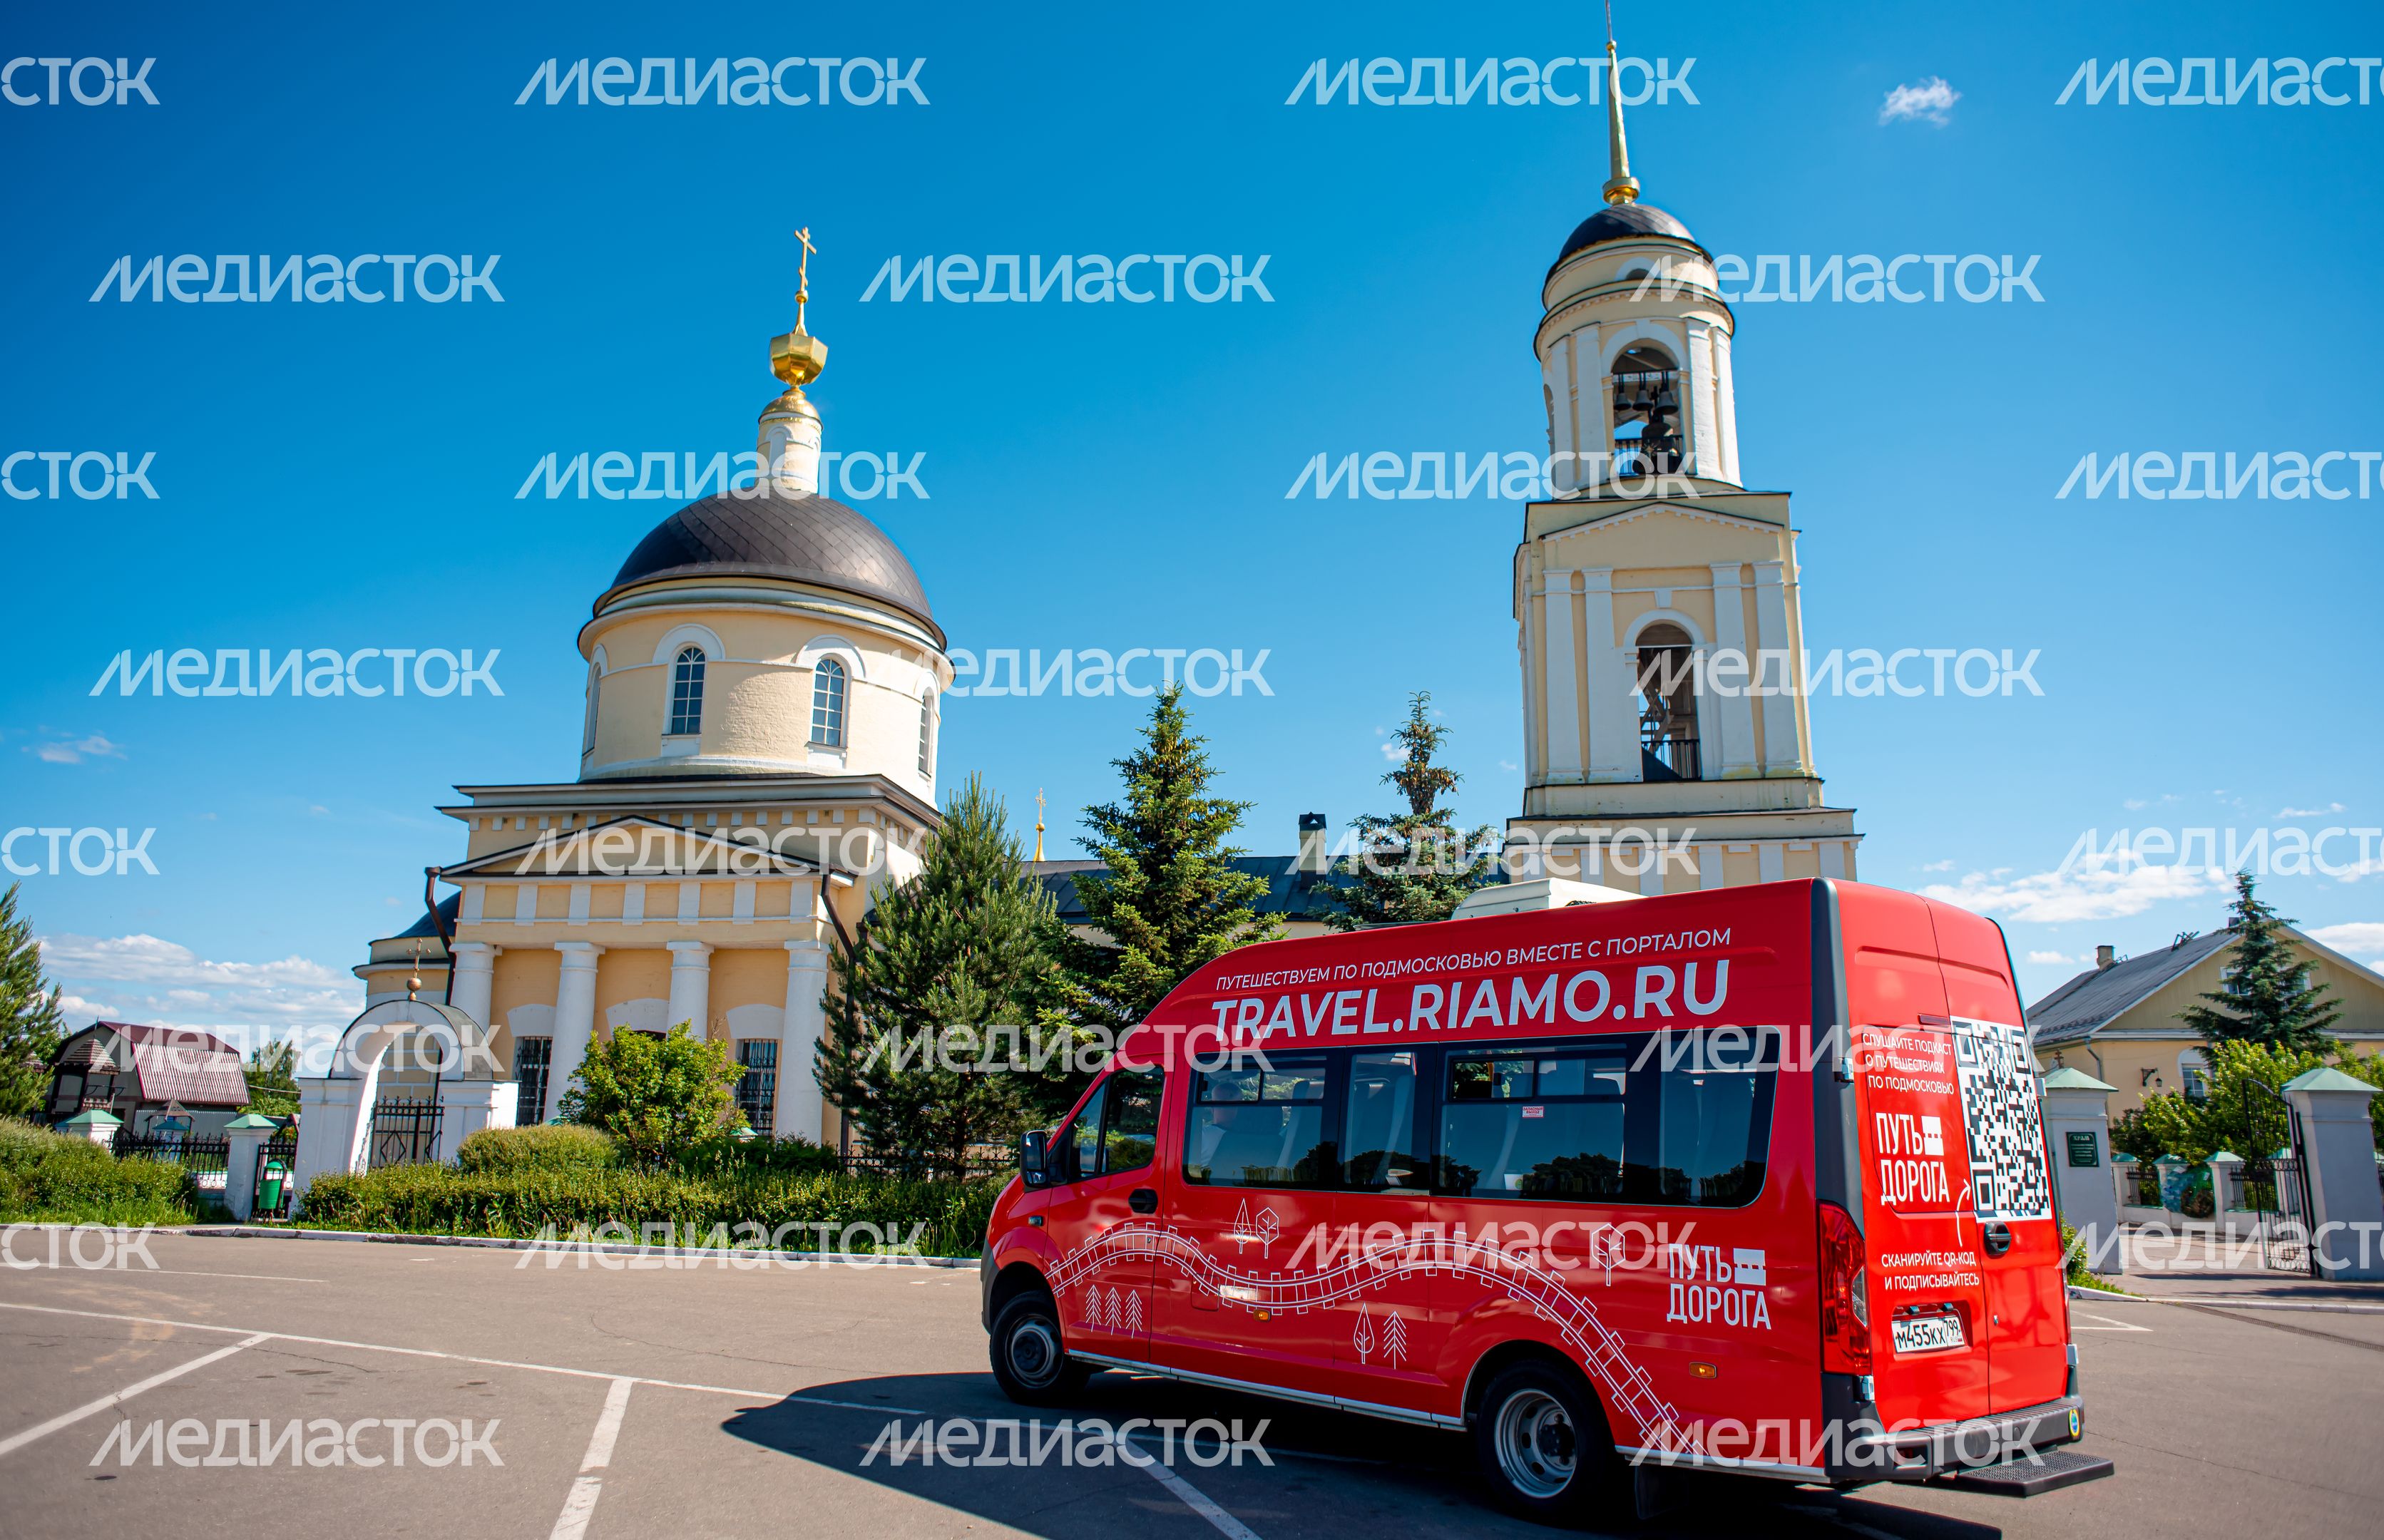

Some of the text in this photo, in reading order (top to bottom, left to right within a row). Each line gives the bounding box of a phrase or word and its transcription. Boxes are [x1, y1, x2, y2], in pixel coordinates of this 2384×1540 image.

[1216, 928, 1731, 990] ПУТЕШЕСТВУЕМ ПО ПОДМОСКОВЬЮ ВМЕСТЕ С ПОРТАЛОМ
[1212, 960, 1729, 1042] TRAVEL.RIAMO.RU
[1915, 1039, 1952, 1055] ПОДКАСТ
[1866, 1054, 1945, 1074] О ПУТЕШЕСТВИЯХ
[1868, 1075, 1954, 1094] ПО ПОДМОСКОВЬЮ
[1876, 1113, 1924, 1155] ПУТЬ
[1881, 1159, 1950, 1206] ДОРОГА
[1669, 1243, 1731, 1283] ПУТЬ
[1881, 1250, 1976, 1267] СКАНИРУЙТЕ QR-КОД
[1885, 1270, 1980, 1291] И ПОДПИСЫВАЙТЕСЬ
[1667, 1283, 1771, 1330] ДОРОГА
[1944, 1320, 1960, 1336] 799
